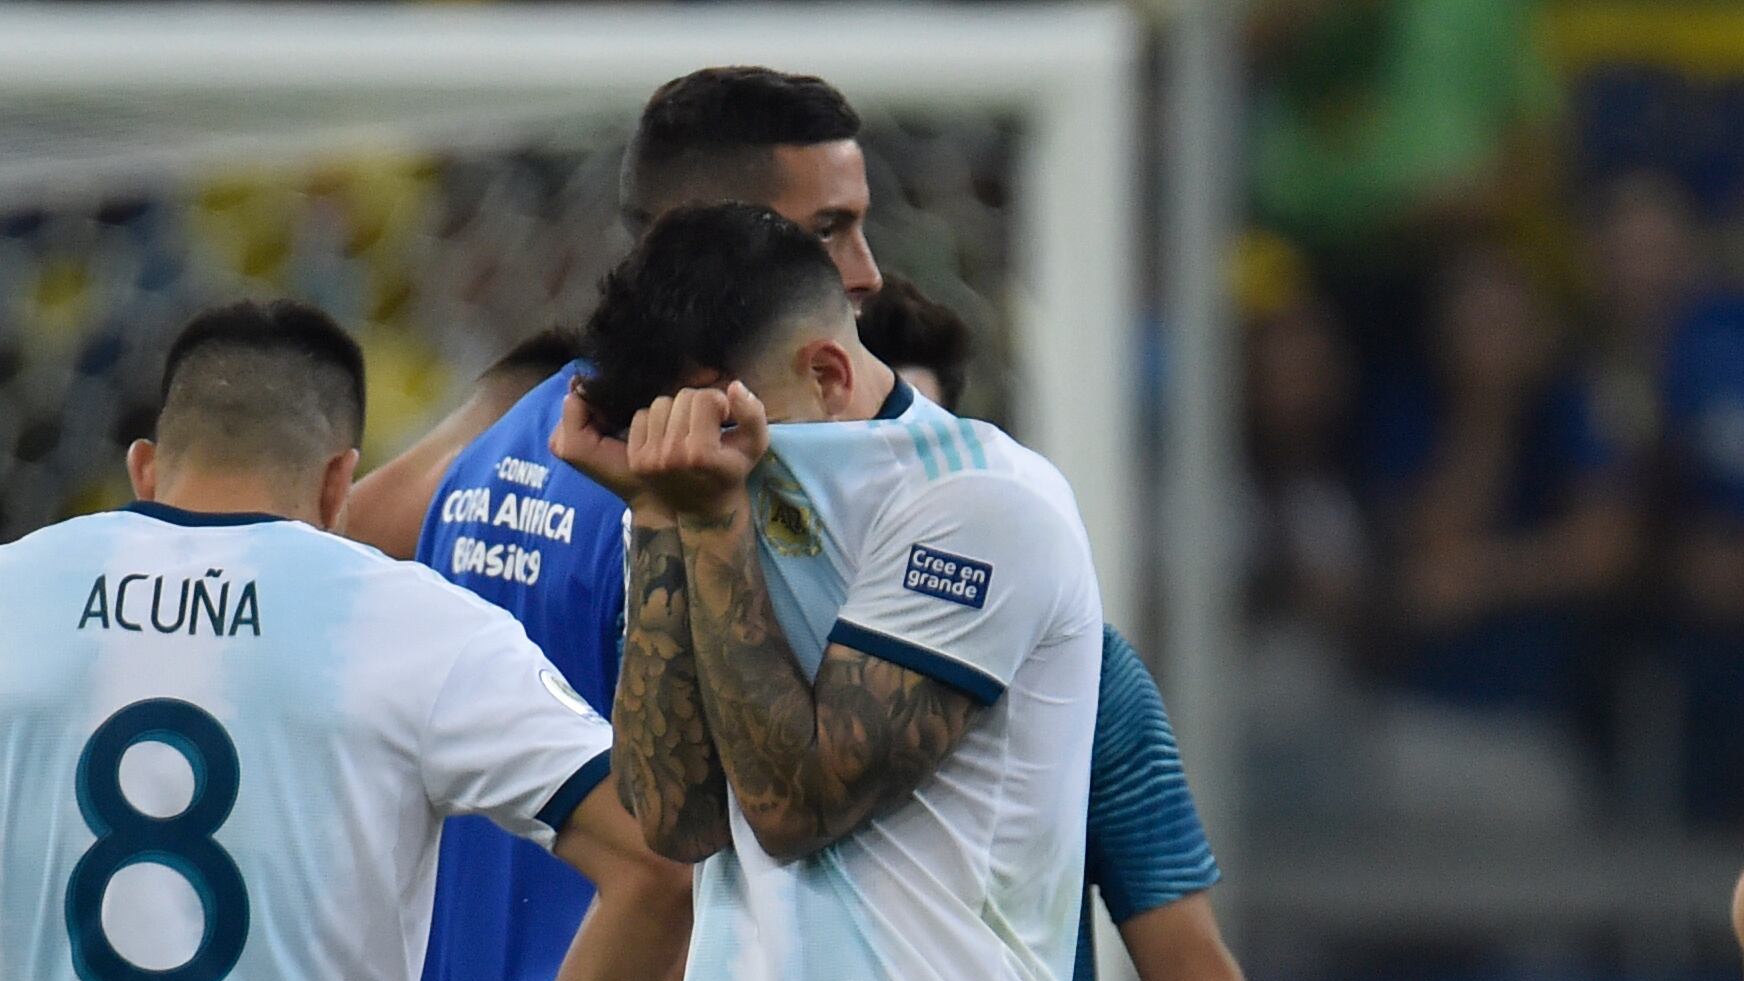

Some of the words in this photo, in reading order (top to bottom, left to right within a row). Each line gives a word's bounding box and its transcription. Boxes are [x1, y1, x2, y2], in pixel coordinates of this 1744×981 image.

[912, 549, 957, 575] Cree
[960, 566, 985, 583] en
[907, 570, 977, 598] grande
[78, 569, 261, 636] ACUÑA
